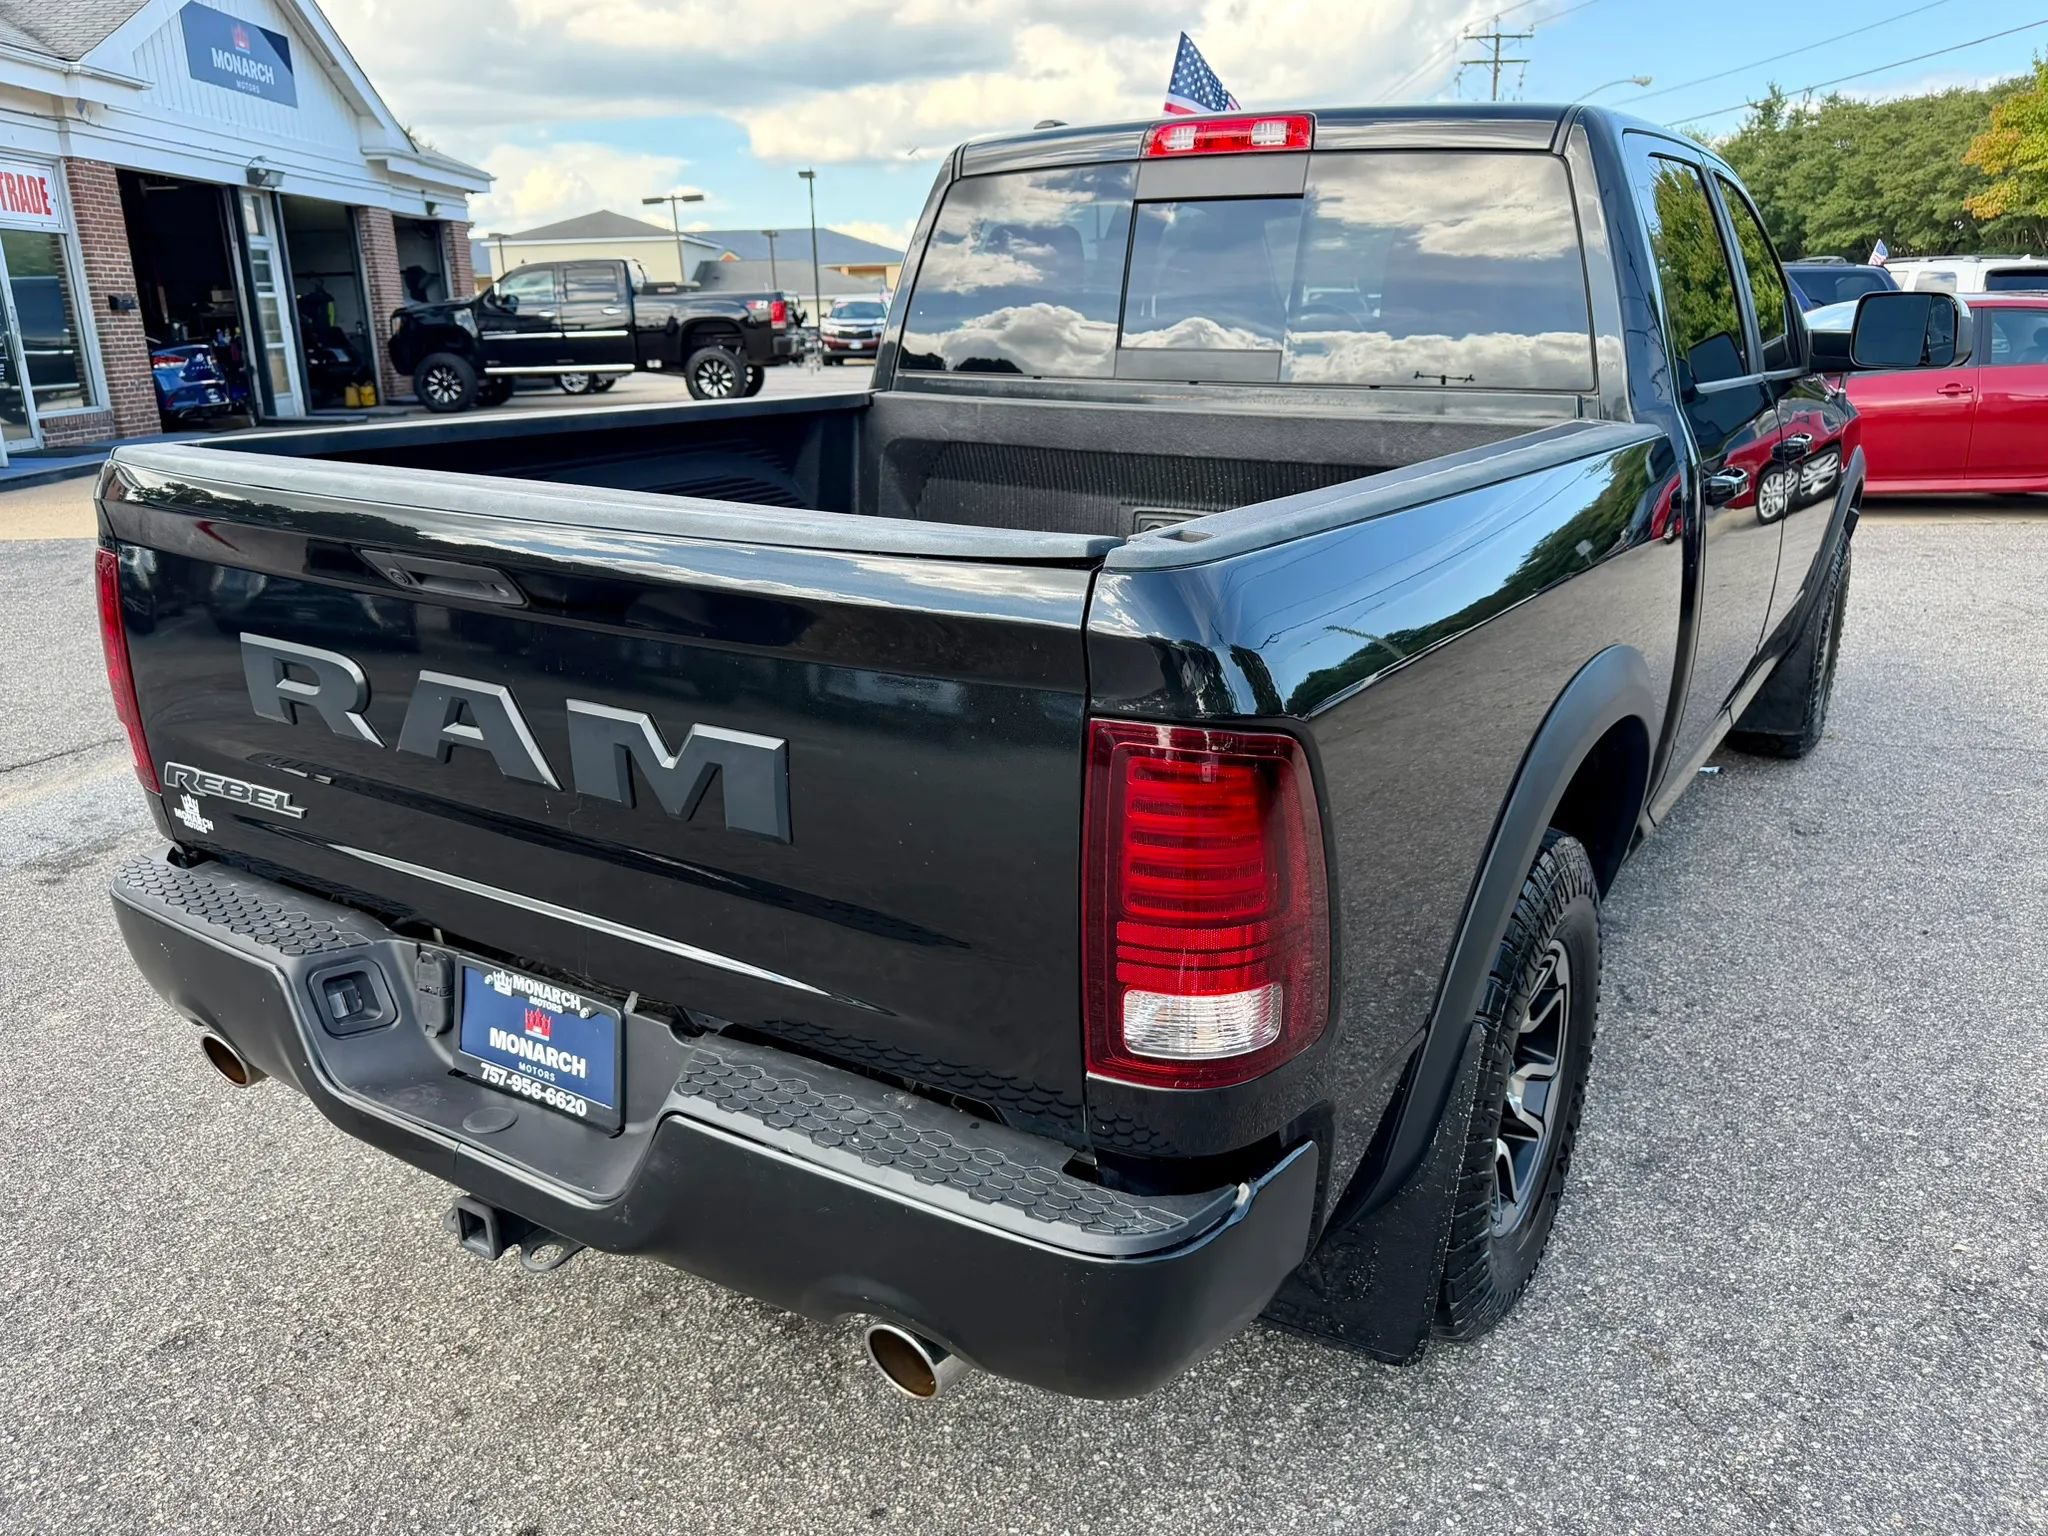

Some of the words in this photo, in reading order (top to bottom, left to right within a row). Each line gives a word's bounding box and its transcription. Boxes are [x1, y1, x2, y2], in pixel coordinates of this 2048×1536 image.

[211, 47, 275, 86] MONARCH
[236, 80, 260, 94] MOTORS
[0, 171, 53, 216] TRADE
[240, 632, 793, 844] RAM
[164, 761, 308, 819] REBEL
[174, 807, 214, 831] MONARCH
[512, 974, 581, 1010] MONARCH
[529, 996, 563, 1014] MOTORS
[489, 1027, 586, 1079] MONARCH
[518, 1062, 556, 1082] MOTORS
[480, 1062, 588, 1117] 757-956-6620
